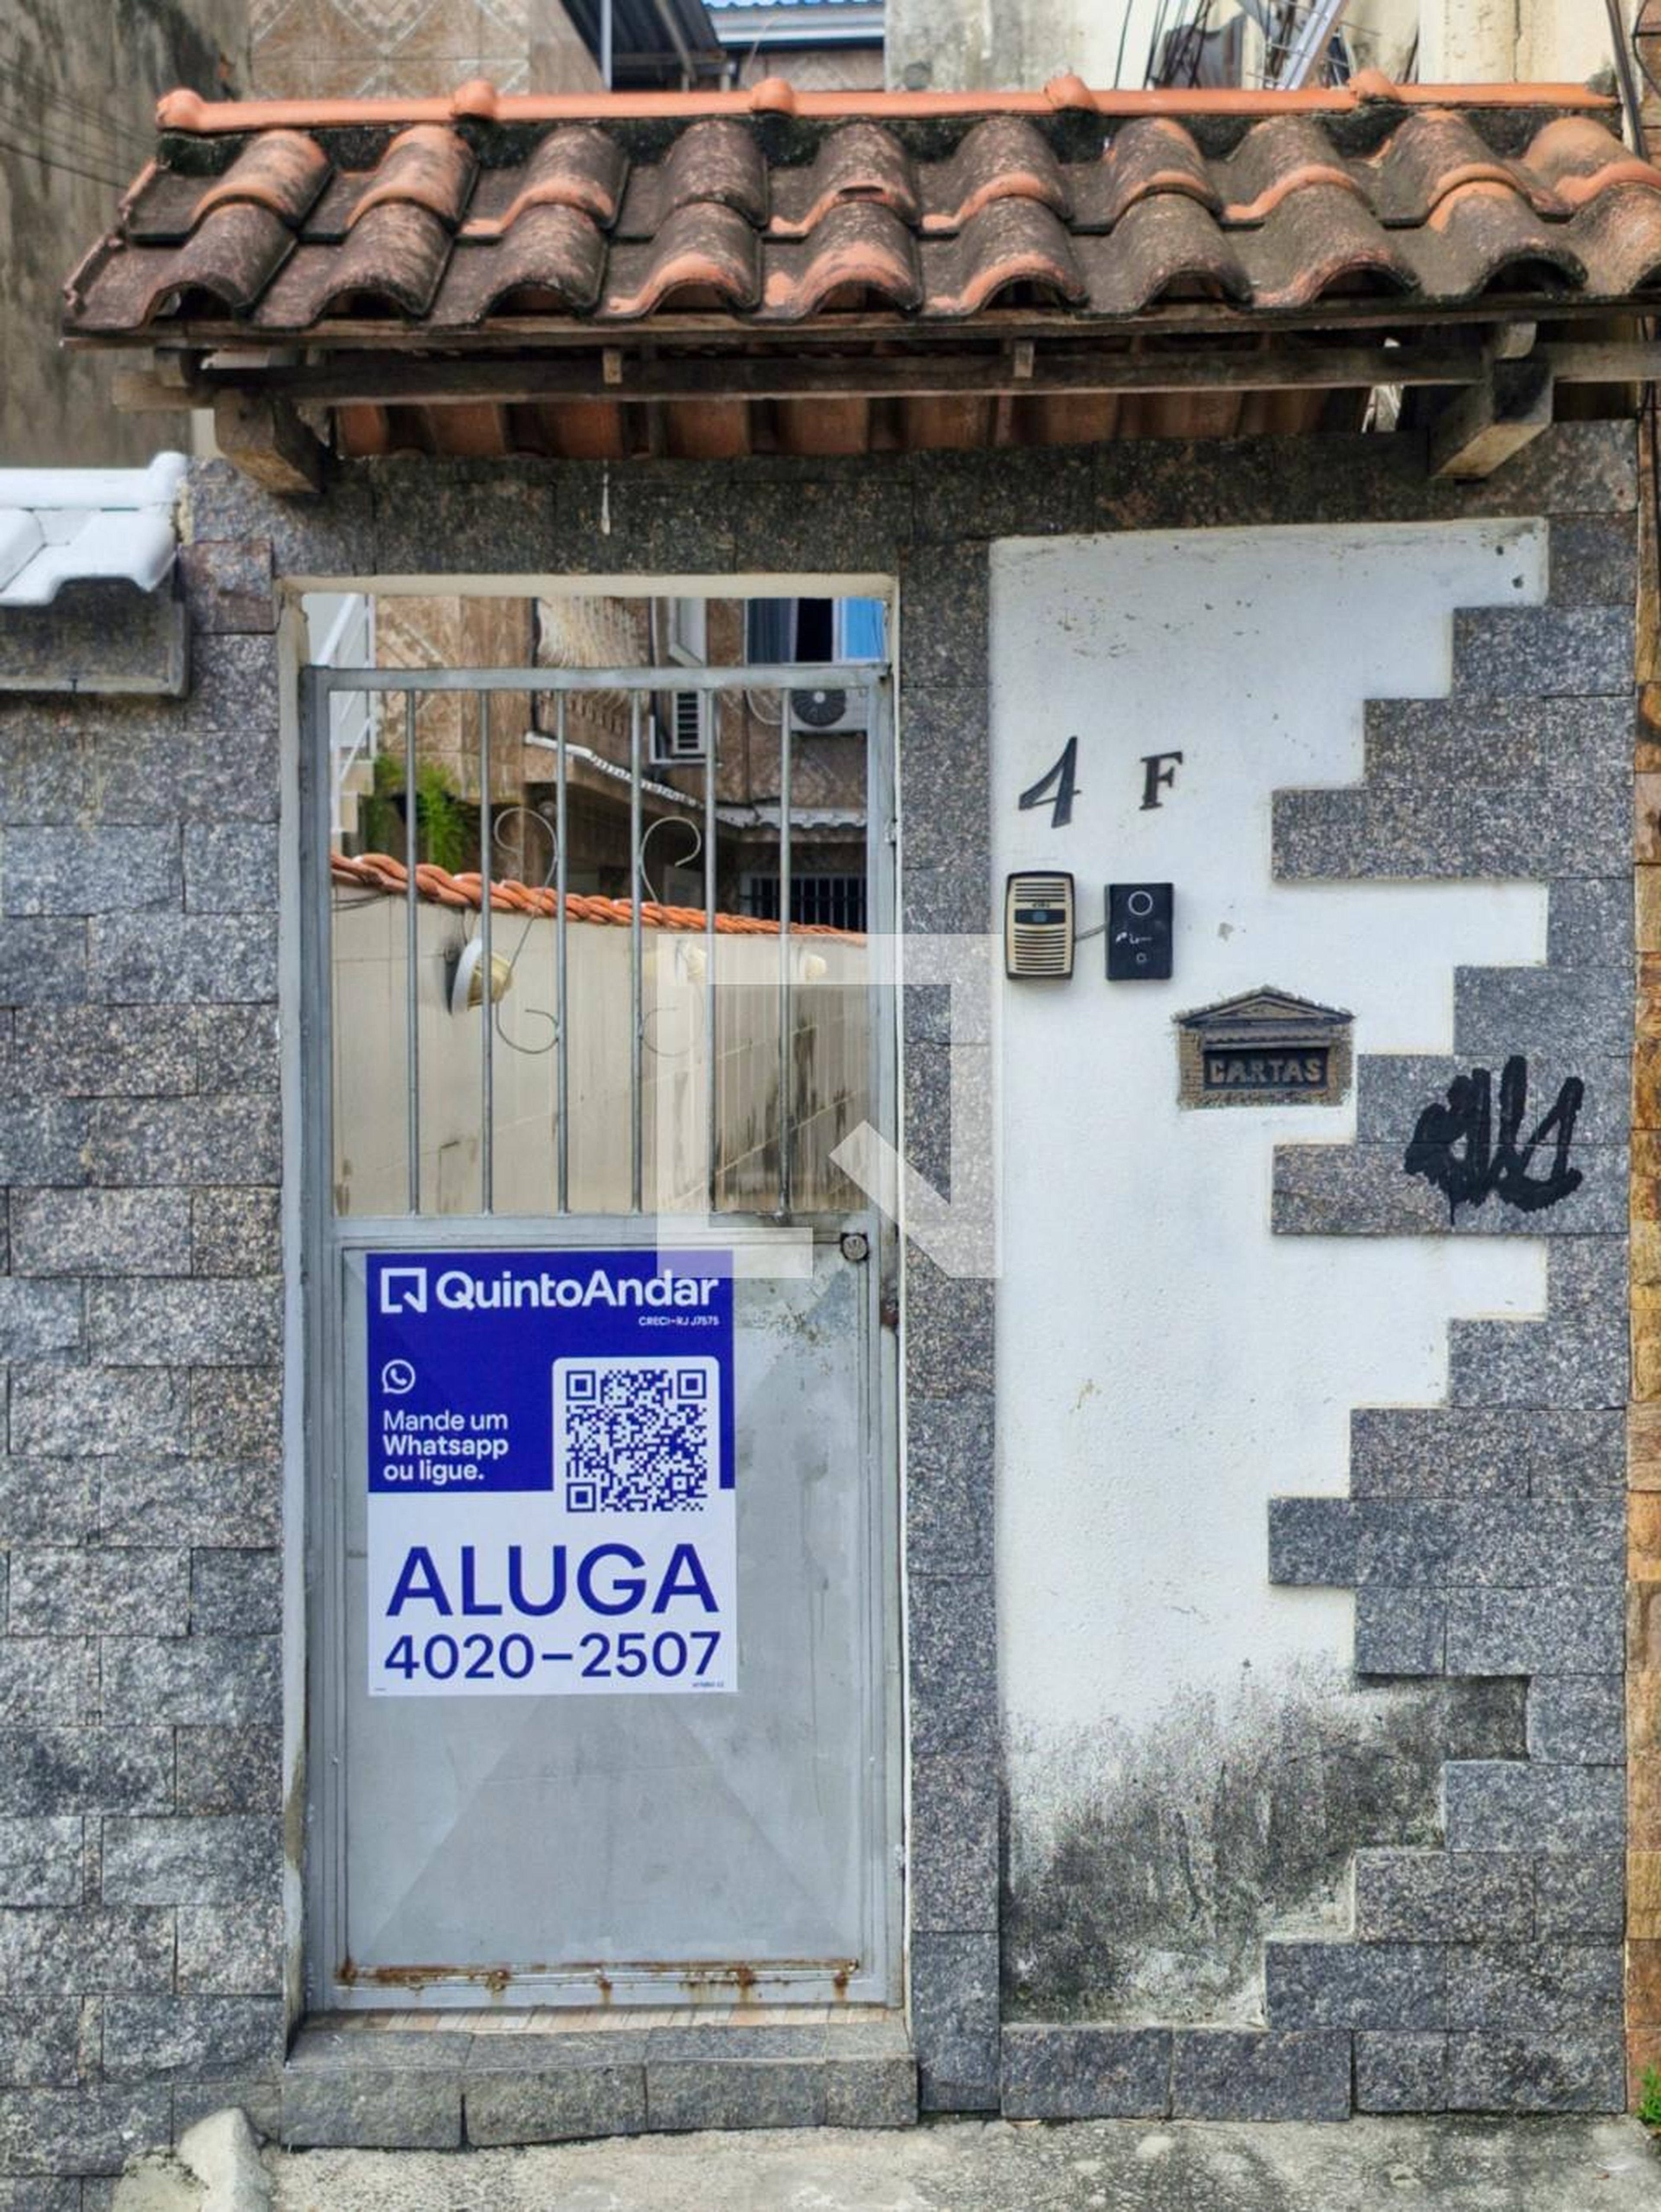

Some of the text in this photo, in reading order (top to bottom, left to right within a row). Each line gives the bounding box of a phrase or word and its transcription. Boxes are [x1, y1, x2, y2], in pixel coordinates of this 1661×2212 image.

[1019, 736, 1183, 828] 4 F
[1211, 1057, 1324, 1085] CARTAS
[435, 1269, 719, 1311] QuintoAndar
[383, 1409, 509, 1431] Mande um
[382, 1434, 509, 1460] Whatsapp
[383, 1460, 484, 1485] ou ligue.
[386, 1543, 720, 1617] ALUGA
[384, 1631, 721, 1680] 4020-2507
